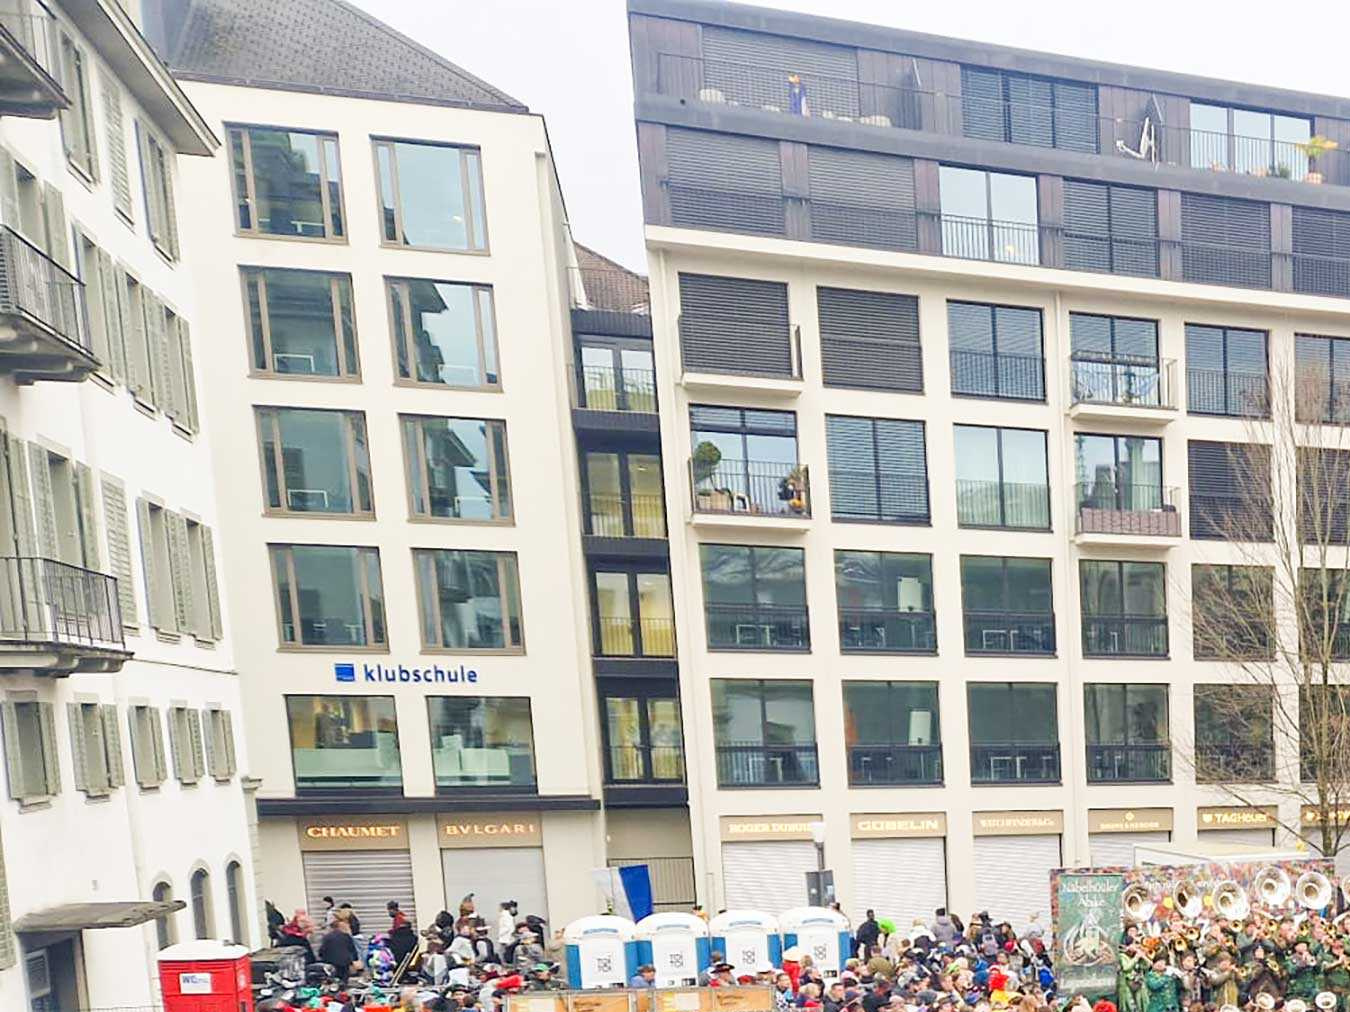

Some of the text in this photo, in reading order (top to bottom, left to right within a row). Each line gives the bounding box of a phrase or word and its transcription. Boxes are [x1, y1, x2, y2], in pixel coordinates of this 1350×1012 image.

[363, 663, 478, 682] klubschule
[306, 825, 400, 838] CHAUMET
[445, 823, 535, 835] BVLGARI
